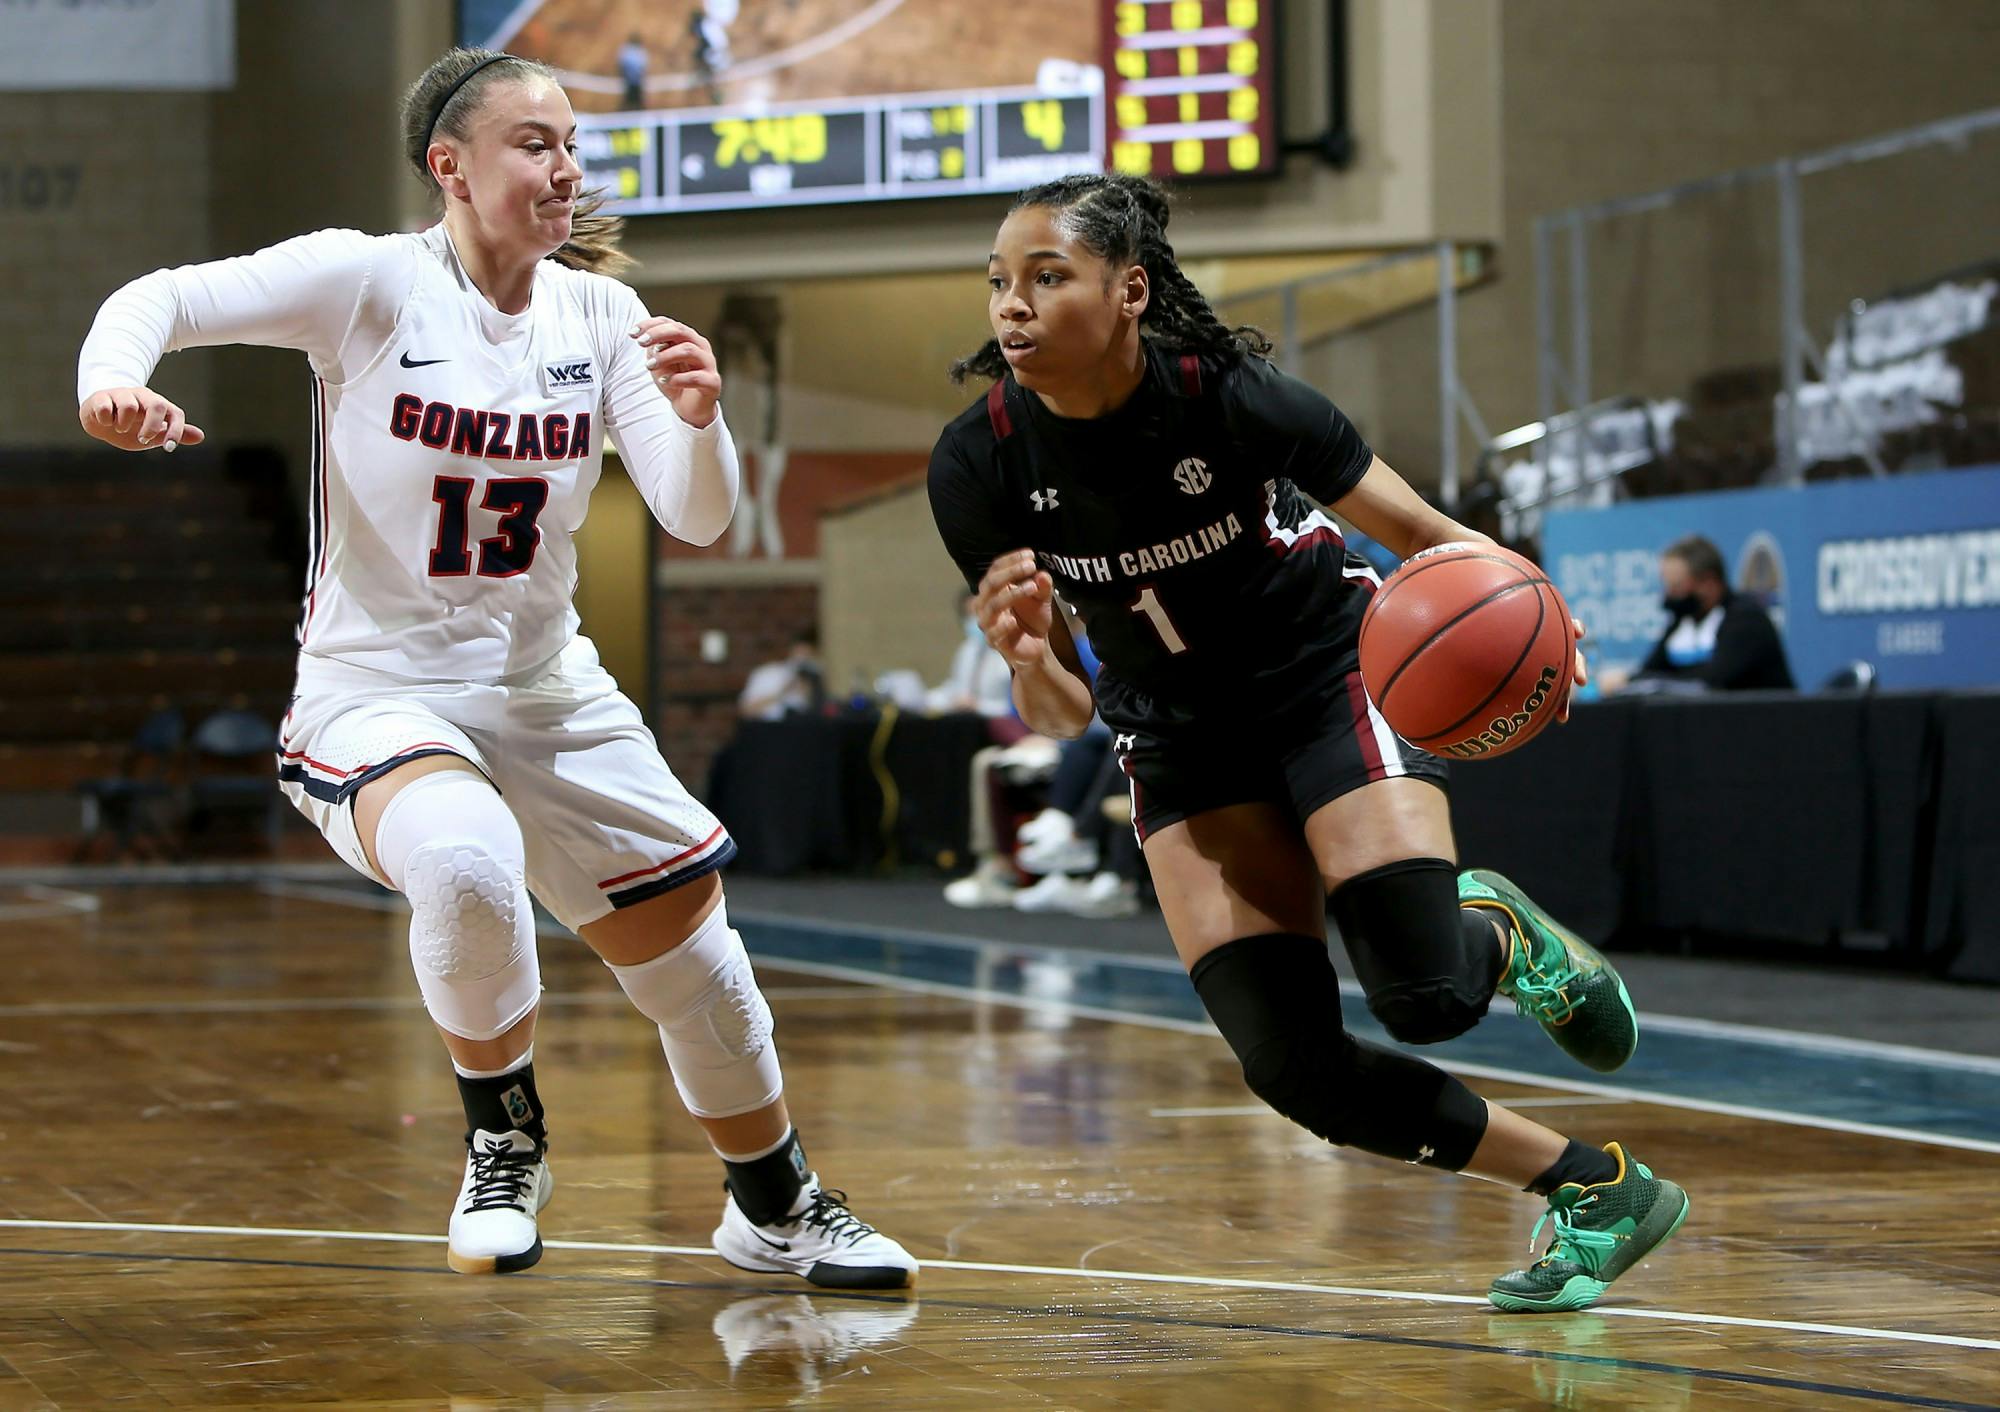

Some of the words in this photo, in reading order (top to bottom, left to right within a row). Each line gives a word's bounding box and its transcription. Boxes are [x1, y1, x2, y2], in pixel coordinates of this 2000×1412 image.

[1021, 100, 1064, 151] 4
[546, 362, 592, 382] WCC
[390, 392, 591, 461] GONZAGA
[1173, 457, 1212, 495] SEC
[428, 475, 549, 578] 13
[1038, 551, 1113, 582] SOUTH
[1118, 512, 1242, 577] CAROLINA
[1130, 588, 1187, 654] 1
[1439, 666, 1558, 757] Wilson
